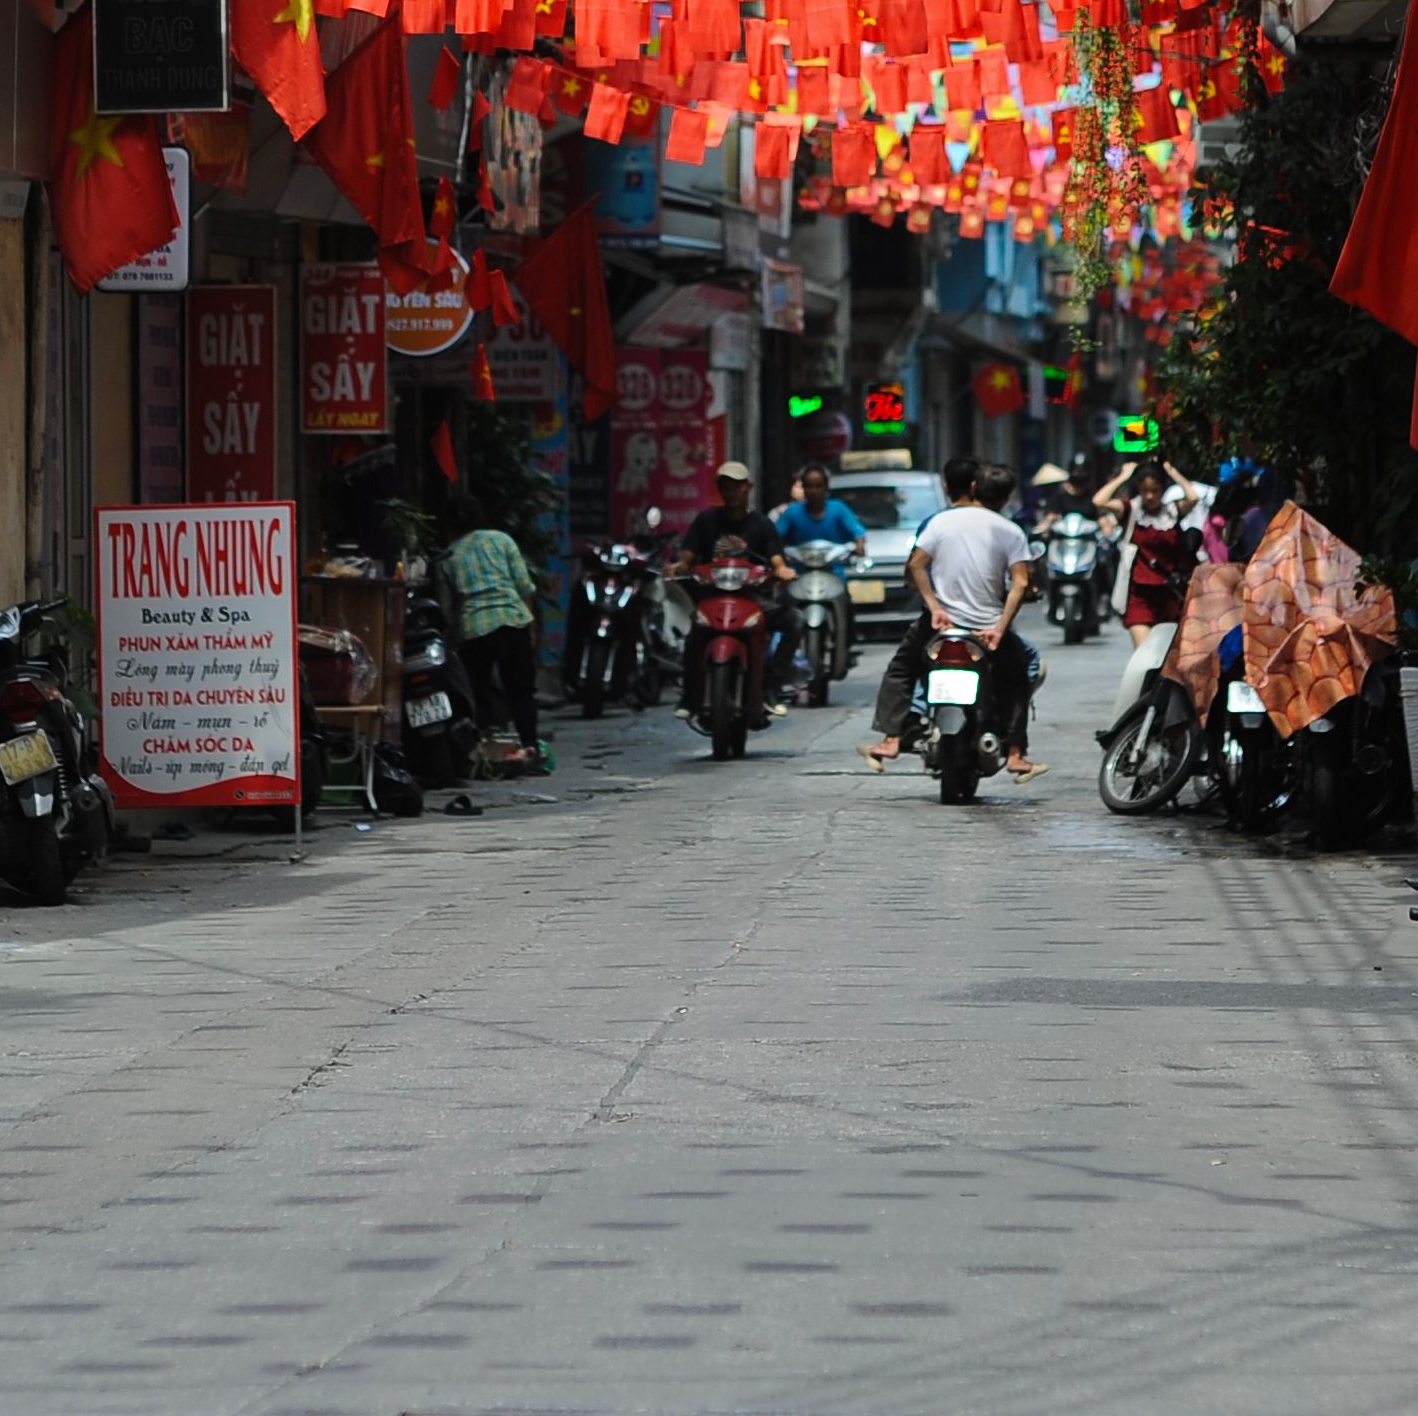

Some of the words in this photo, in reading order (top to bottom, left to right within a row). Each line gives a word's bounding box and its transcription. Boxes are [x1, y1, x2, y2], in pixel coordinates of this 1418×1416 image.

[305, 285, 380, 345] GIẶT
[199, 301, 264, 379] GIẶT
[310, 346, 377, 404] SẤY
[203, 382, 261, 456] SẤY
[108, 519, 190, 599] TRANG
[194, 518, 283, 598] NHUNG
[141, 607, 196, 626] Beauty
[200, 607, 214, 623] &
[218, 606, 251, 626] Spa
[118, 636, 162, 652] PHUN
[201, 657, 243, 682] phong
[147, 690, 168, 709] TRỊ
[173, 690, 192, 706] DA
[196, 685, 255, 706] CHUYÊN
[232, 736, 255, 753] DA
[270, 752, 291, 778] gel
